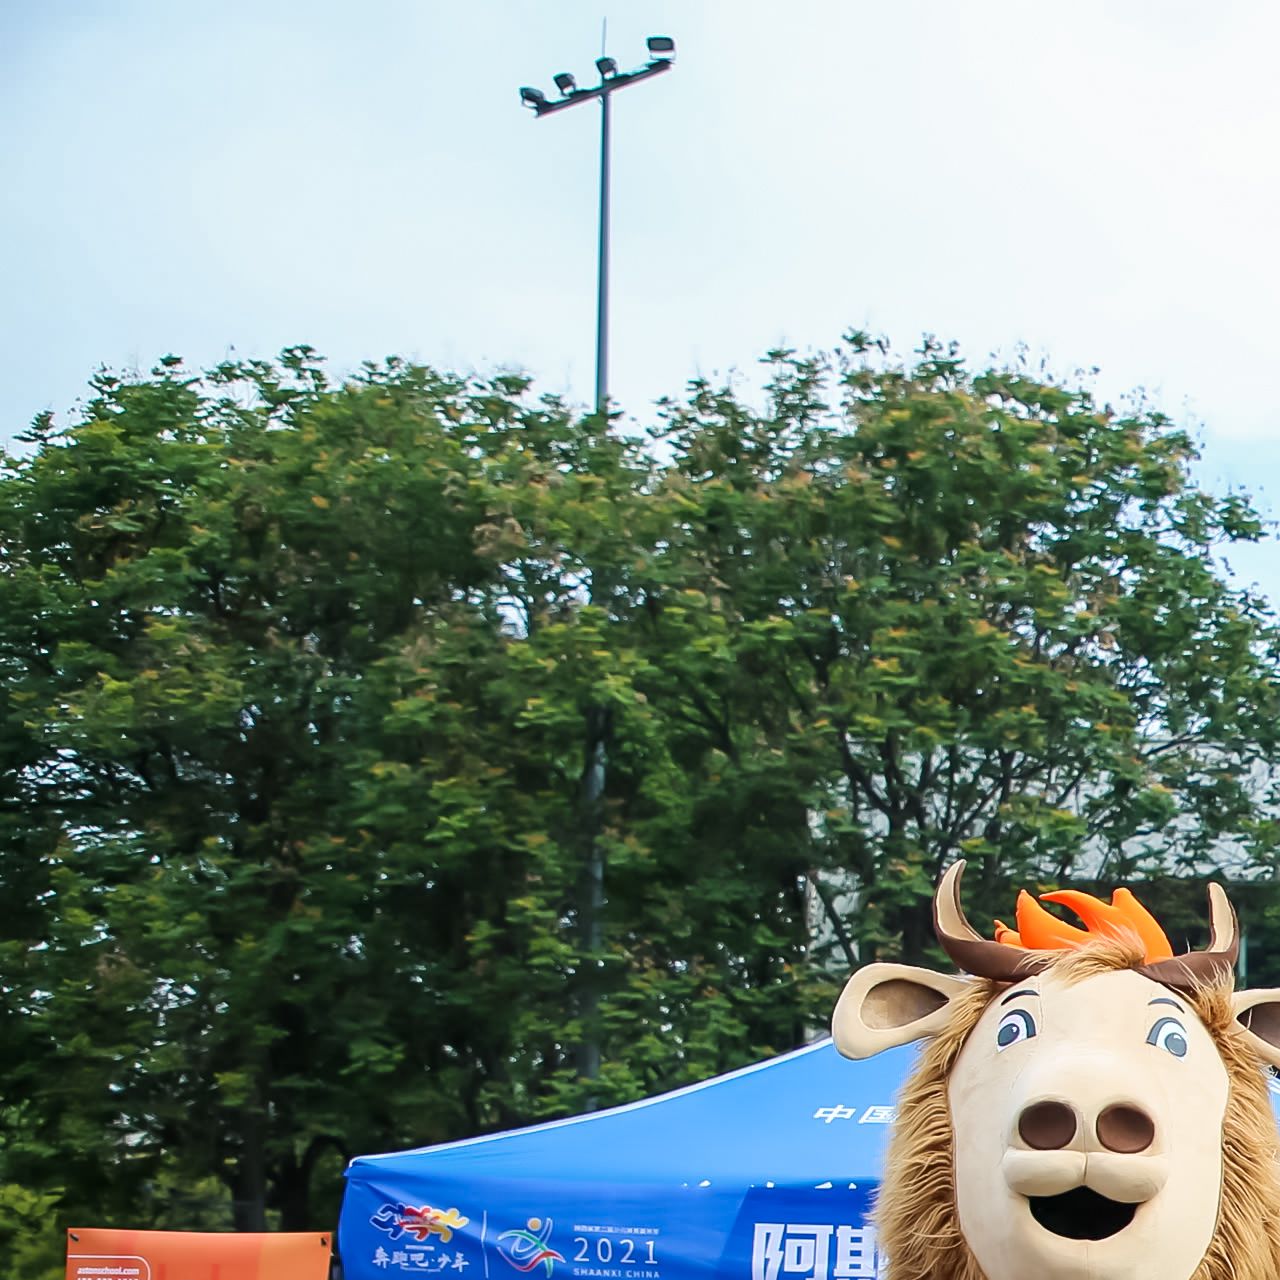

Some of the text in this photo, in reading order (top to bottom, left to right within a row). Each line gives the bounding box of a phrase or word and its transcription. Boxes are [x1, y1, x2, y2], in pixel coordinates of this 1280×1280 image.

[573, 1237, 658, 1264] 2021
[573, 1268, 660, 1278] SHAANXI CHINA
